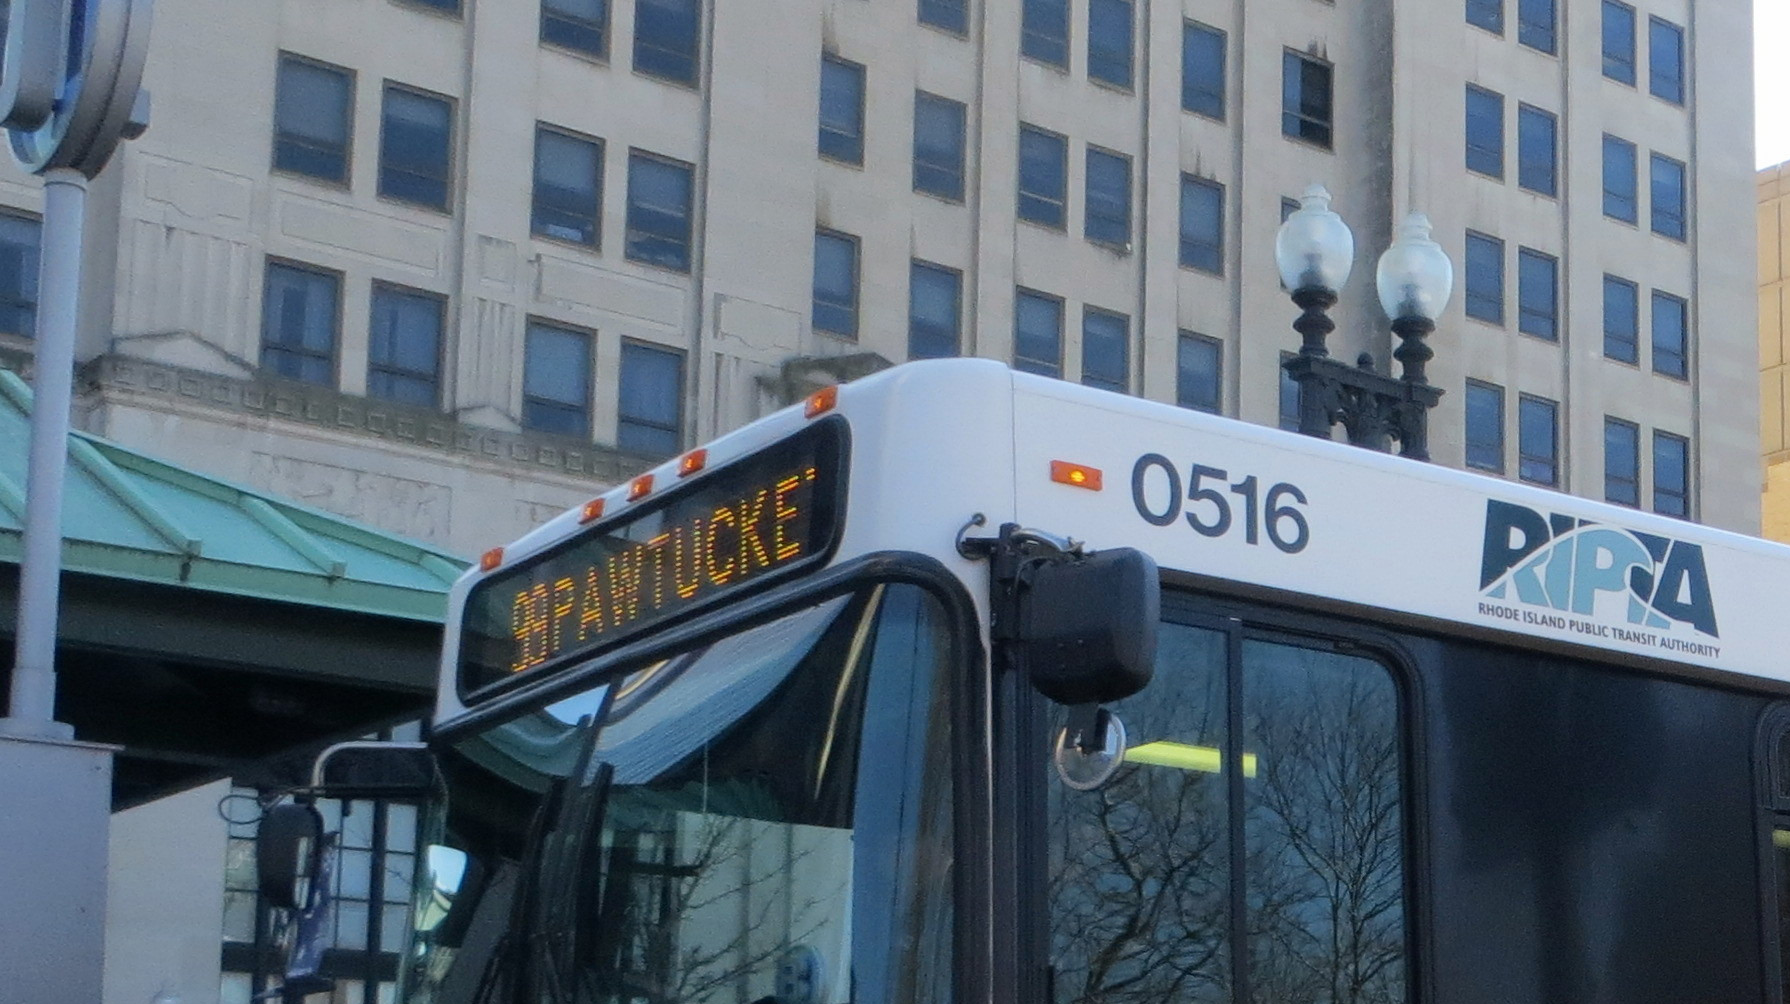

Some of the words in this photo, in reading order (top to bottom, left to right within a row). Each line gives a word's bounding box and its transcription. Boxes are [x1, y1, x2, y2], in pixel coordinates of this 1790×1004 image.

[553, 466, 816, 651] PAWTUCKE
[1131, 452, 1310, 555] 0516
[1478, 601, 1520, 622] RHODE
[1523, 610, 1566, 630] ISLAND
[1569, 617, 1609, 638] PUBLIC
[1612, 627, 1657, 647] TRANSIT
[1660, 636, 1721, 659] AUTHORITY
[1479, 498, 1721, 640] RIPTA
